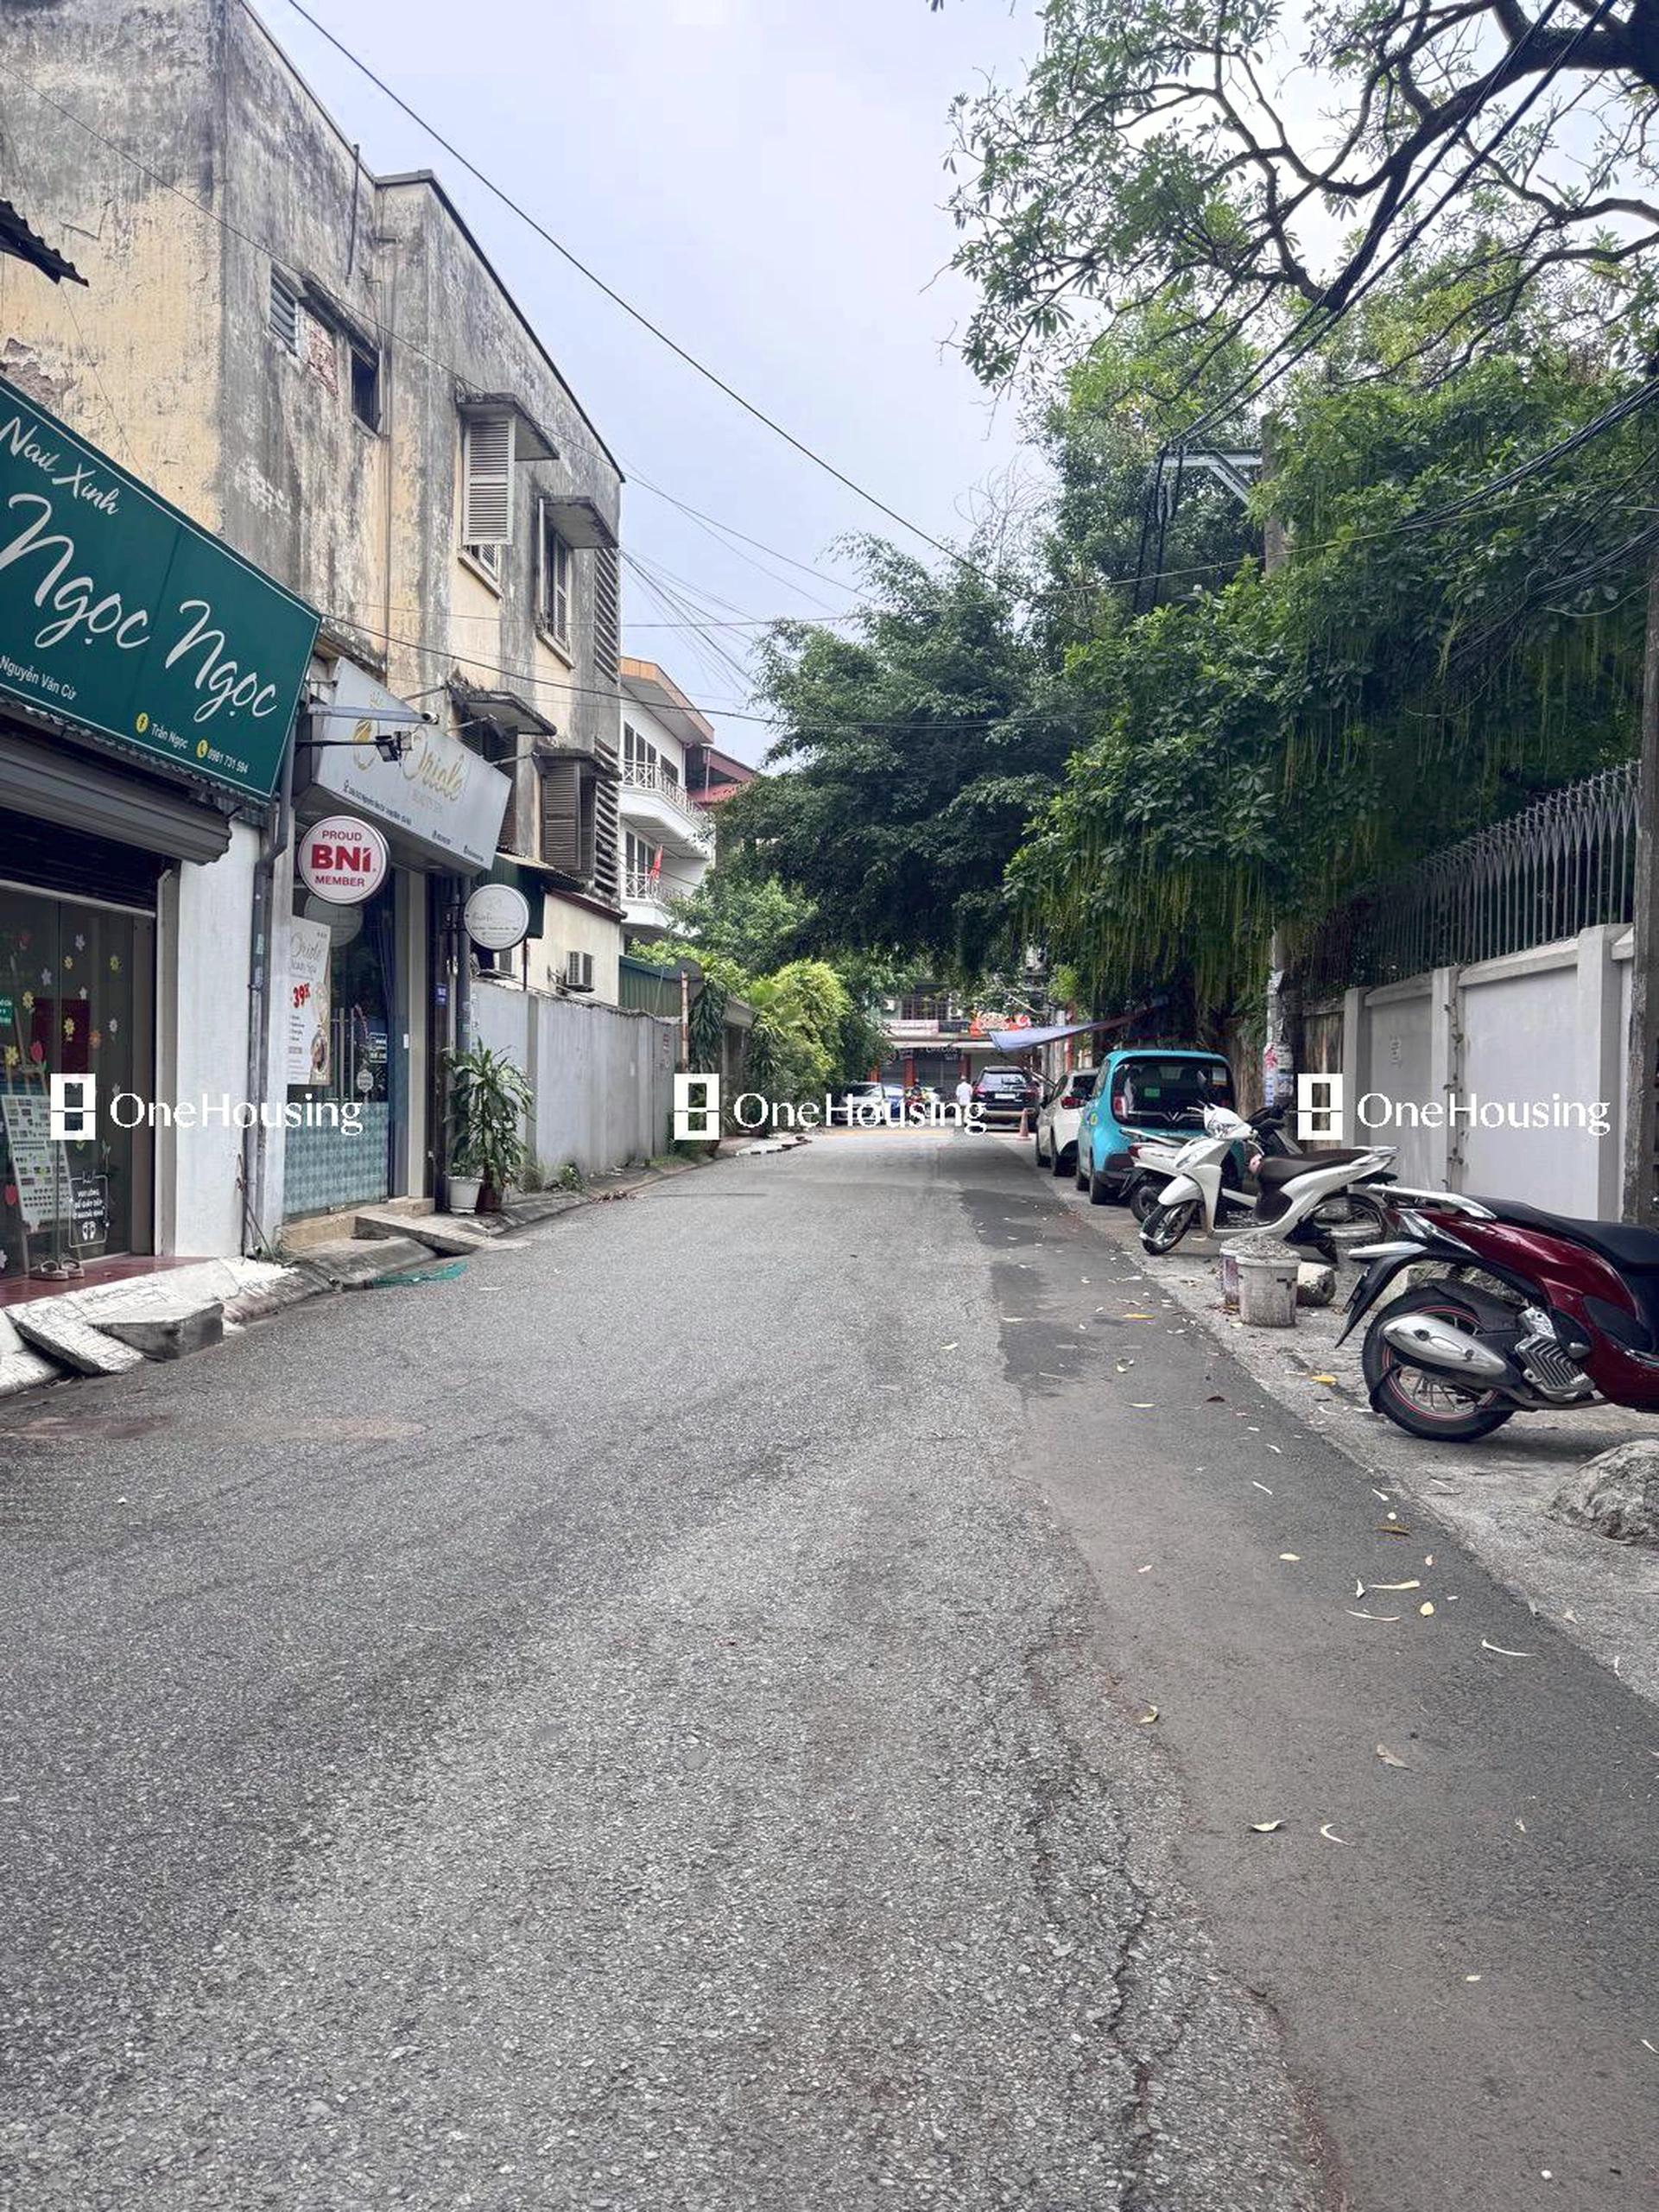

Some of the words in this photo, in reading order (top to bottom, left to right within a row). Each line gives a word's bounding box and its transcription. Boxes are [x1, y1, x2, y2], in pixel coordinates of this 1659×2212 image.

[0, 416, 57, 473] Nail
[52, 462, 120, 517] Xinh
[0, 492, 151, 650] Ngọc
[165, 599, 277, 724] Ngọc
[322, 831, 363, 841] PROUD
[314, 876, 365, 887] MEMBER
